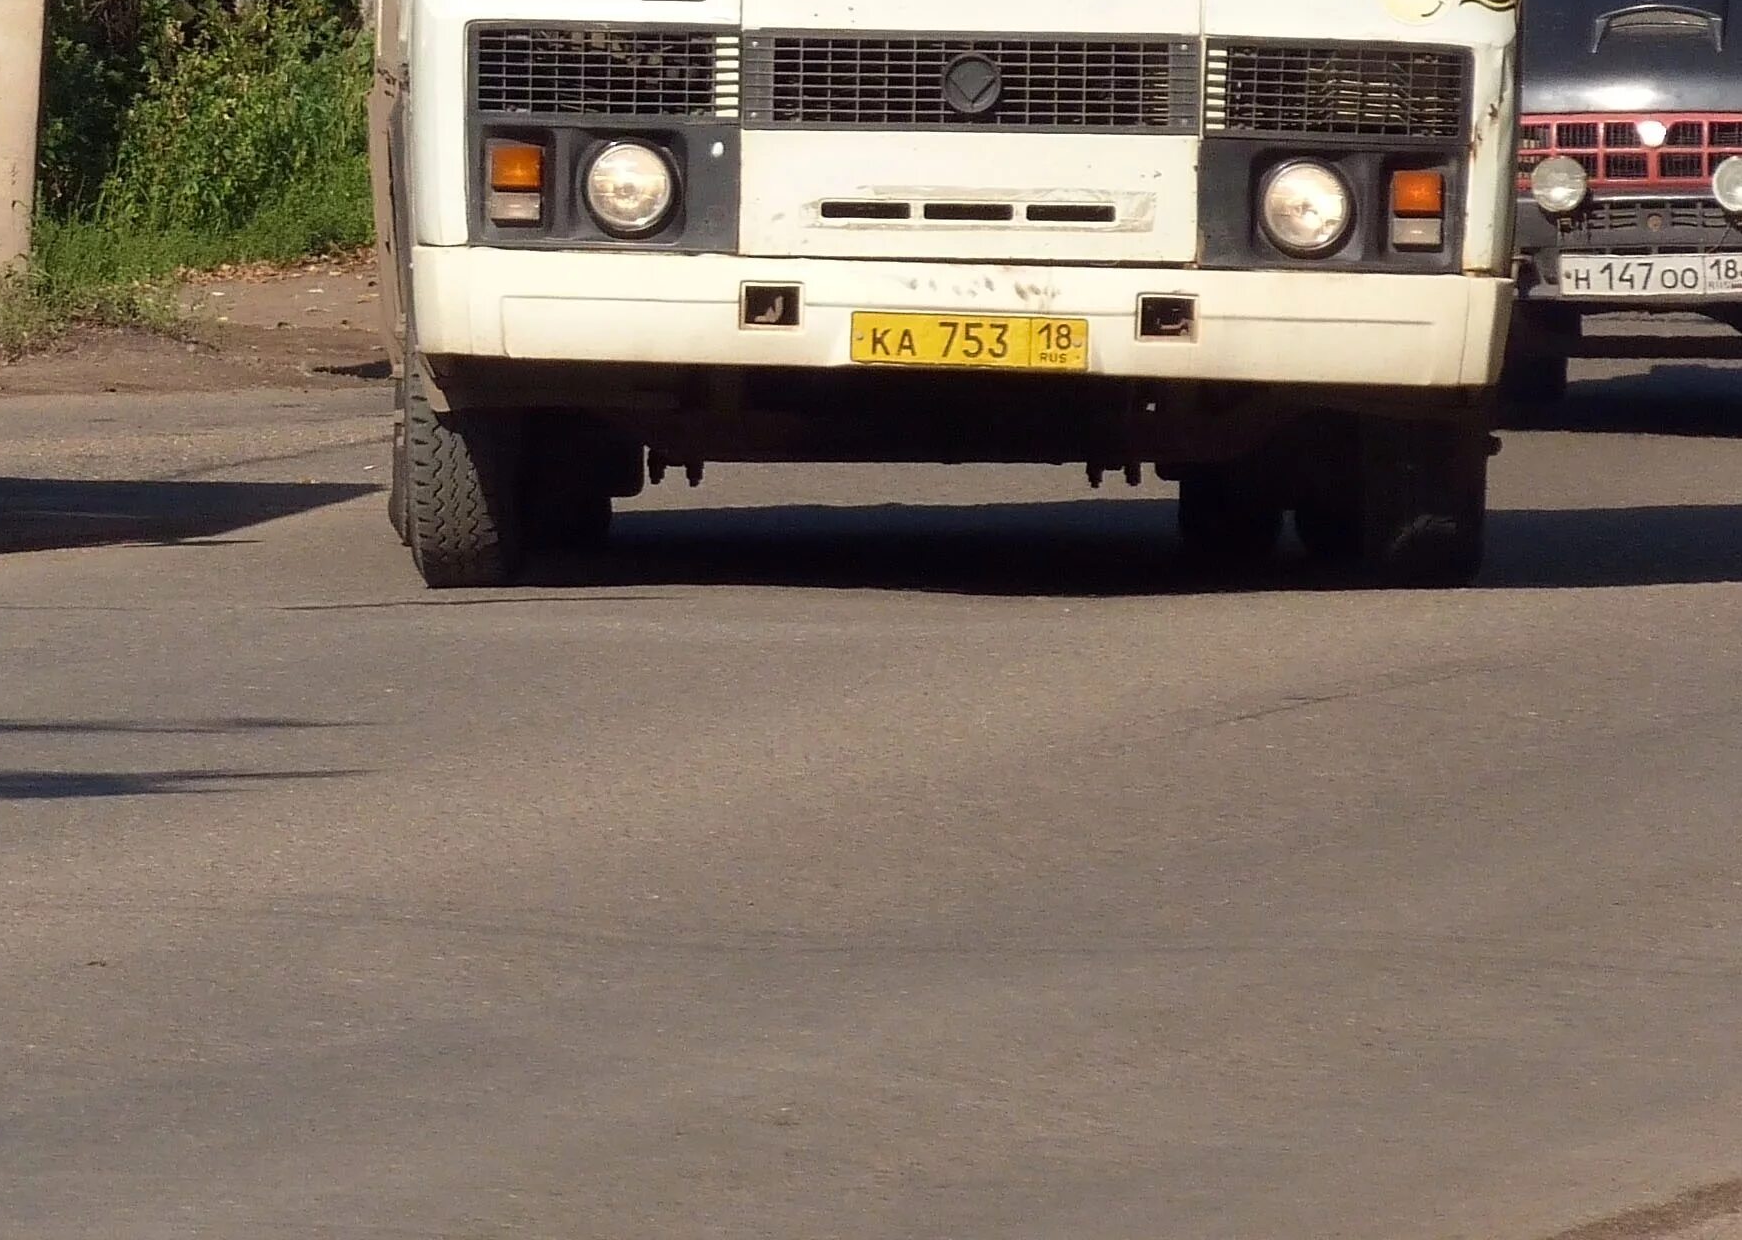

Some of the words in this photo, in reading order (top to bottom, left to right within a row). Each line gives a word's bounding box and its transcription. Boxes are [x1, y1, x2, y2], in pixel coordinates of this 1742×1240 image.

[1600, 262, 1654, 290] 147
[1710, 259, 1738, 280] 18
[872, 327, 917, 357] КА
[939, 321, 1010, 359] 753
[1038, 323, 1072, 351] 18
[1040, 353, 1067, 364] RUS
